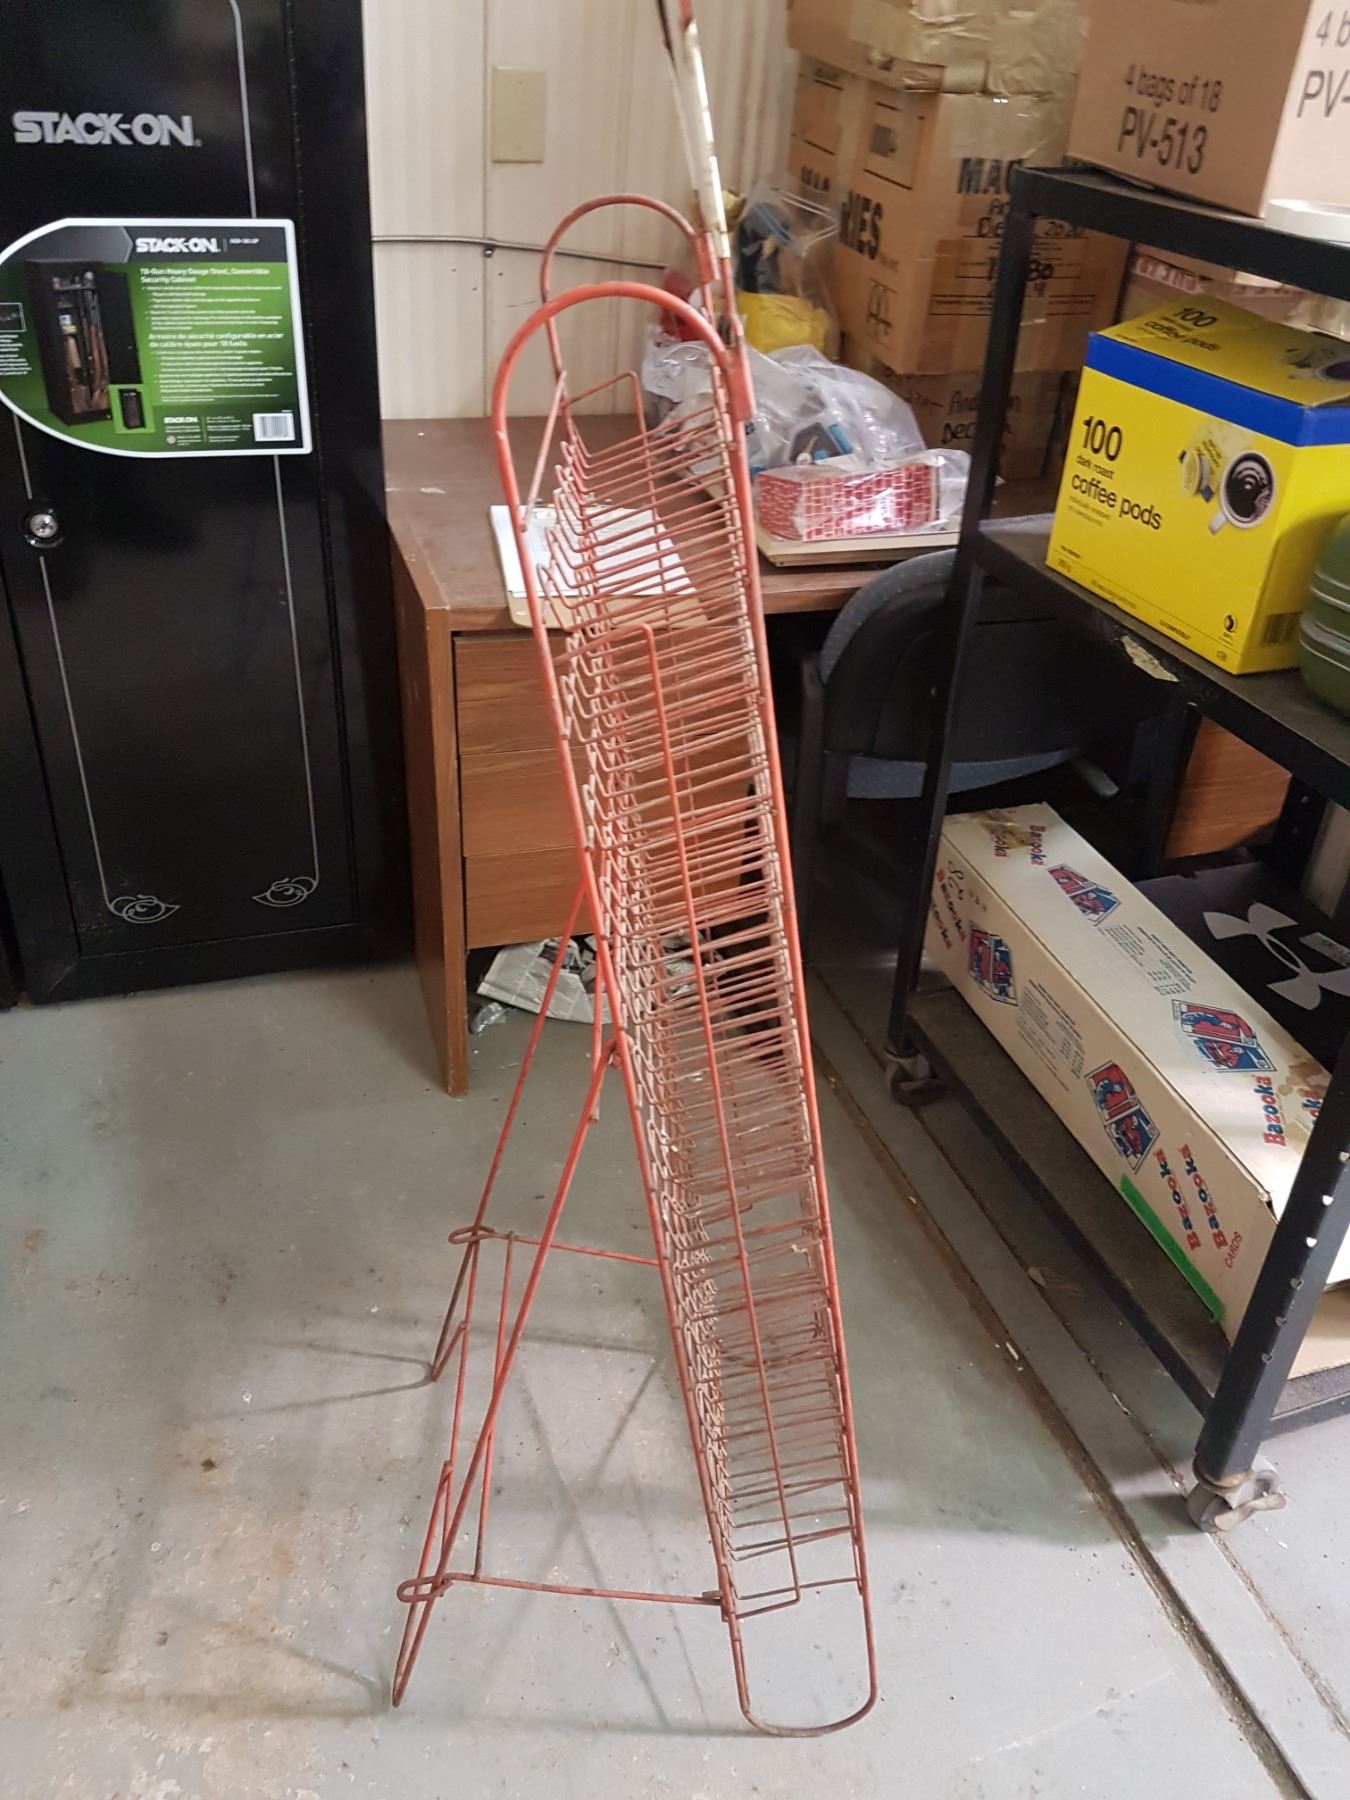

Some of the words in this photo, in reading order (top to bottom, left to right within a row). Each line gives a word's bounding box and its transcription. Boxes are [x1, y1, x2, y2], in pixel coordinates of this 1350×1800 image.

[1125, 64, 1136, 92] 4
[1137, 65, 1175, 109] bags
[1178, 74, 1200, 106] of
[1202, 79, 1223, 113] 18
[13, 111, 194, 147] STACK-ON
[1117, 105, 1208, 175] PV-513
[135, 237, 218, 253] STACK-ON
[1176, 305, 1219, 329] 100
[1083, 414, 1123, 462] 100
[1092, 463, 1115, 480] roast
[1071, 473, 1117, 508] coffee
[1118, 497, 1163, 530] pods
[1254, 1073, 1287, 1147] Bazooka
[1153, 1147, 1202, 1251] Bazooka
[1178, 1143, 1229, 1250] Bazooka
[1224, 1231, 1243, 1270] CARDS
